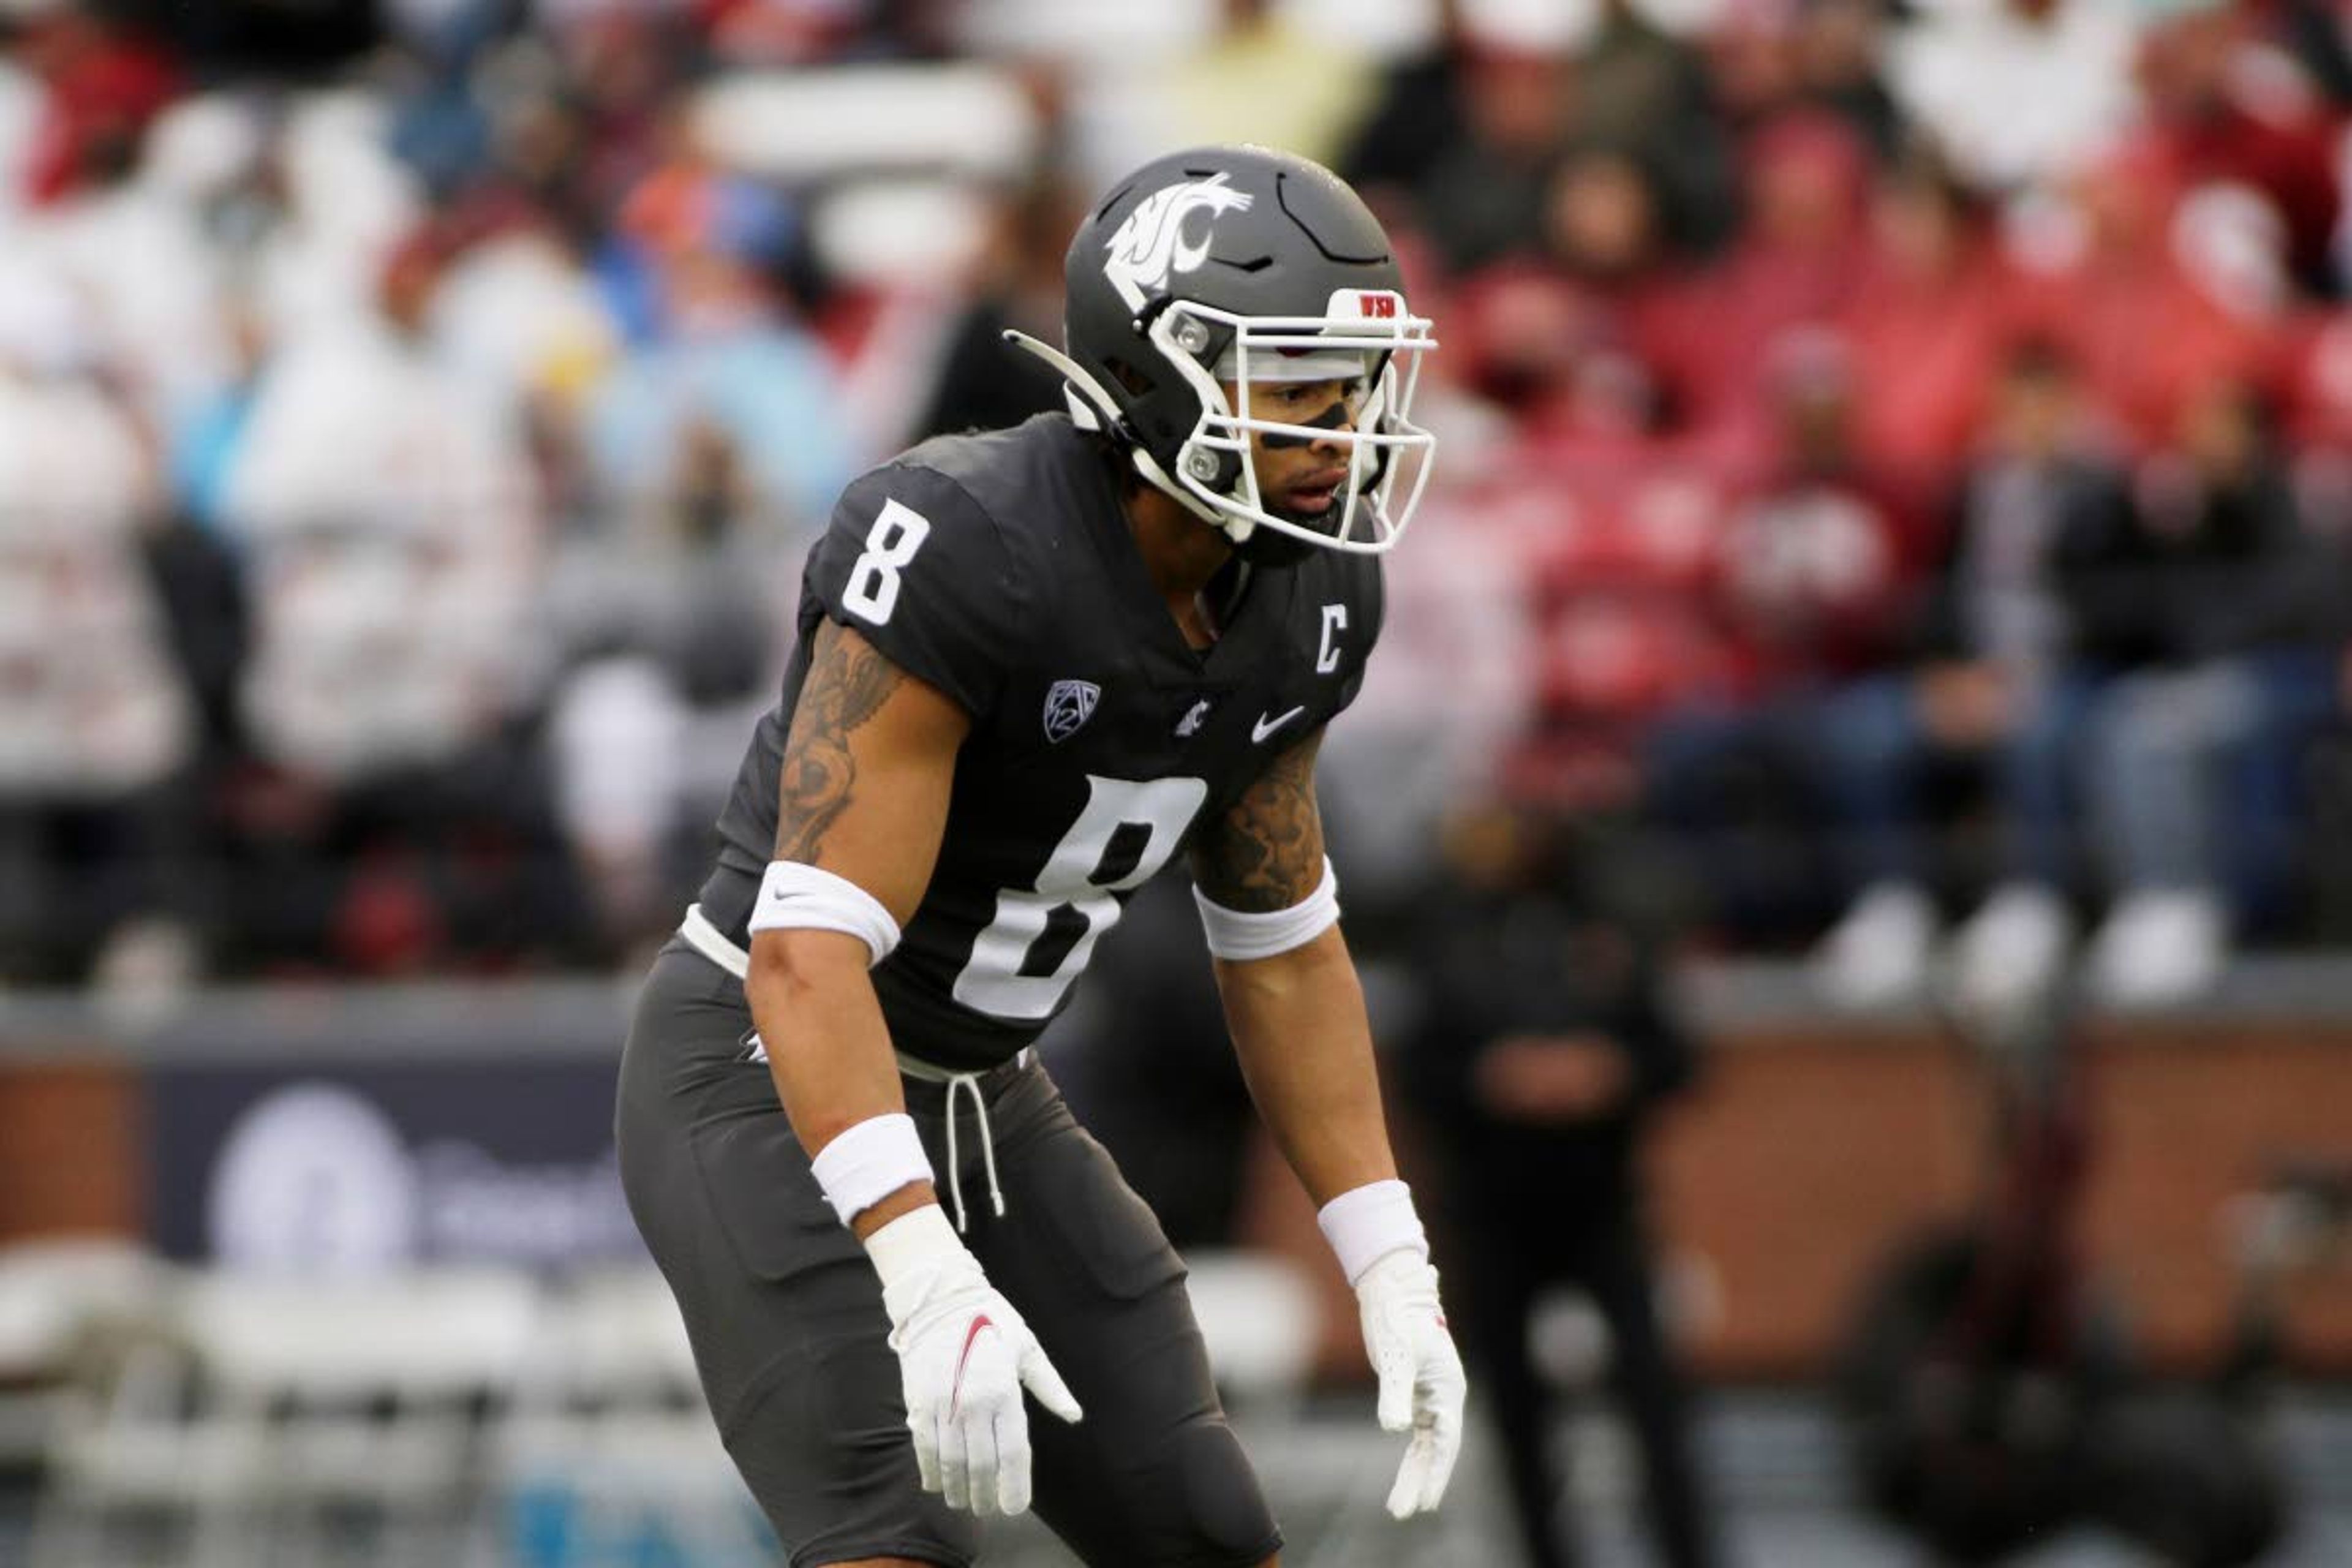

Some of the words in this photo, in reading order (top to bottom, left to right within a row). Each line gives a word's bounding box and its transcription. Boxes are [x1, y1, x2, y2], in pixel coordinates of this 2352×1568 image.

[842, 497, 930, 626] 8
[1317, 604, 1347, 673] C
[1050, 707, 1078, 729] 12
[953, 774, 1207, 1019] 8
